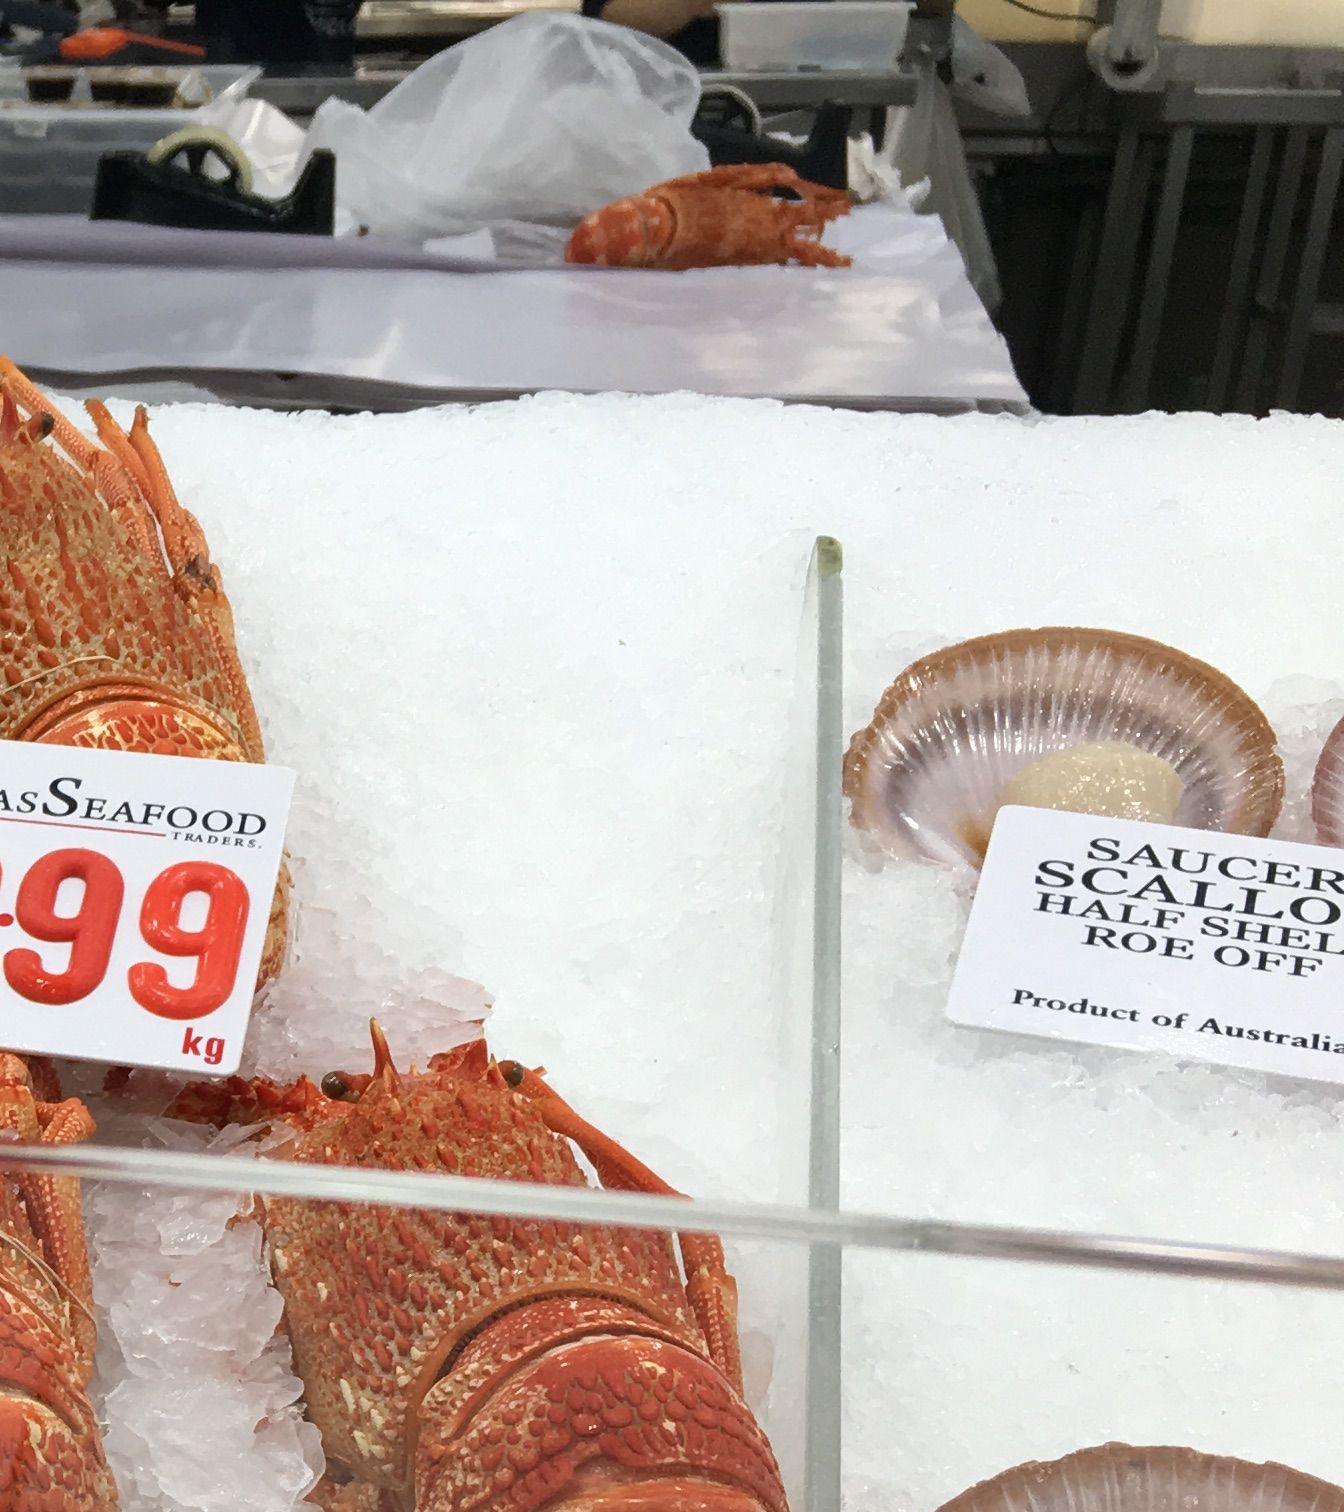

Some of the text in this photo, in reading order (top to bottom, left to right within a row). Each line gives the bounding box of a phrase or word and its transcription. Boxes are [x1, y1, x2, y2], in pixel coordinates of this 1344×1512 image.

[1034, 860, 1342, 926] SCALLO
[1087, 836, 1344, 896] SAUCER
[1033, 892, 1185, 930] HALF
[1081, 924, 1323, 978] ROE OFF
[181, 1027, 225, 1065] kg
[1011, 988, 1344, 1055] Product of Australia
